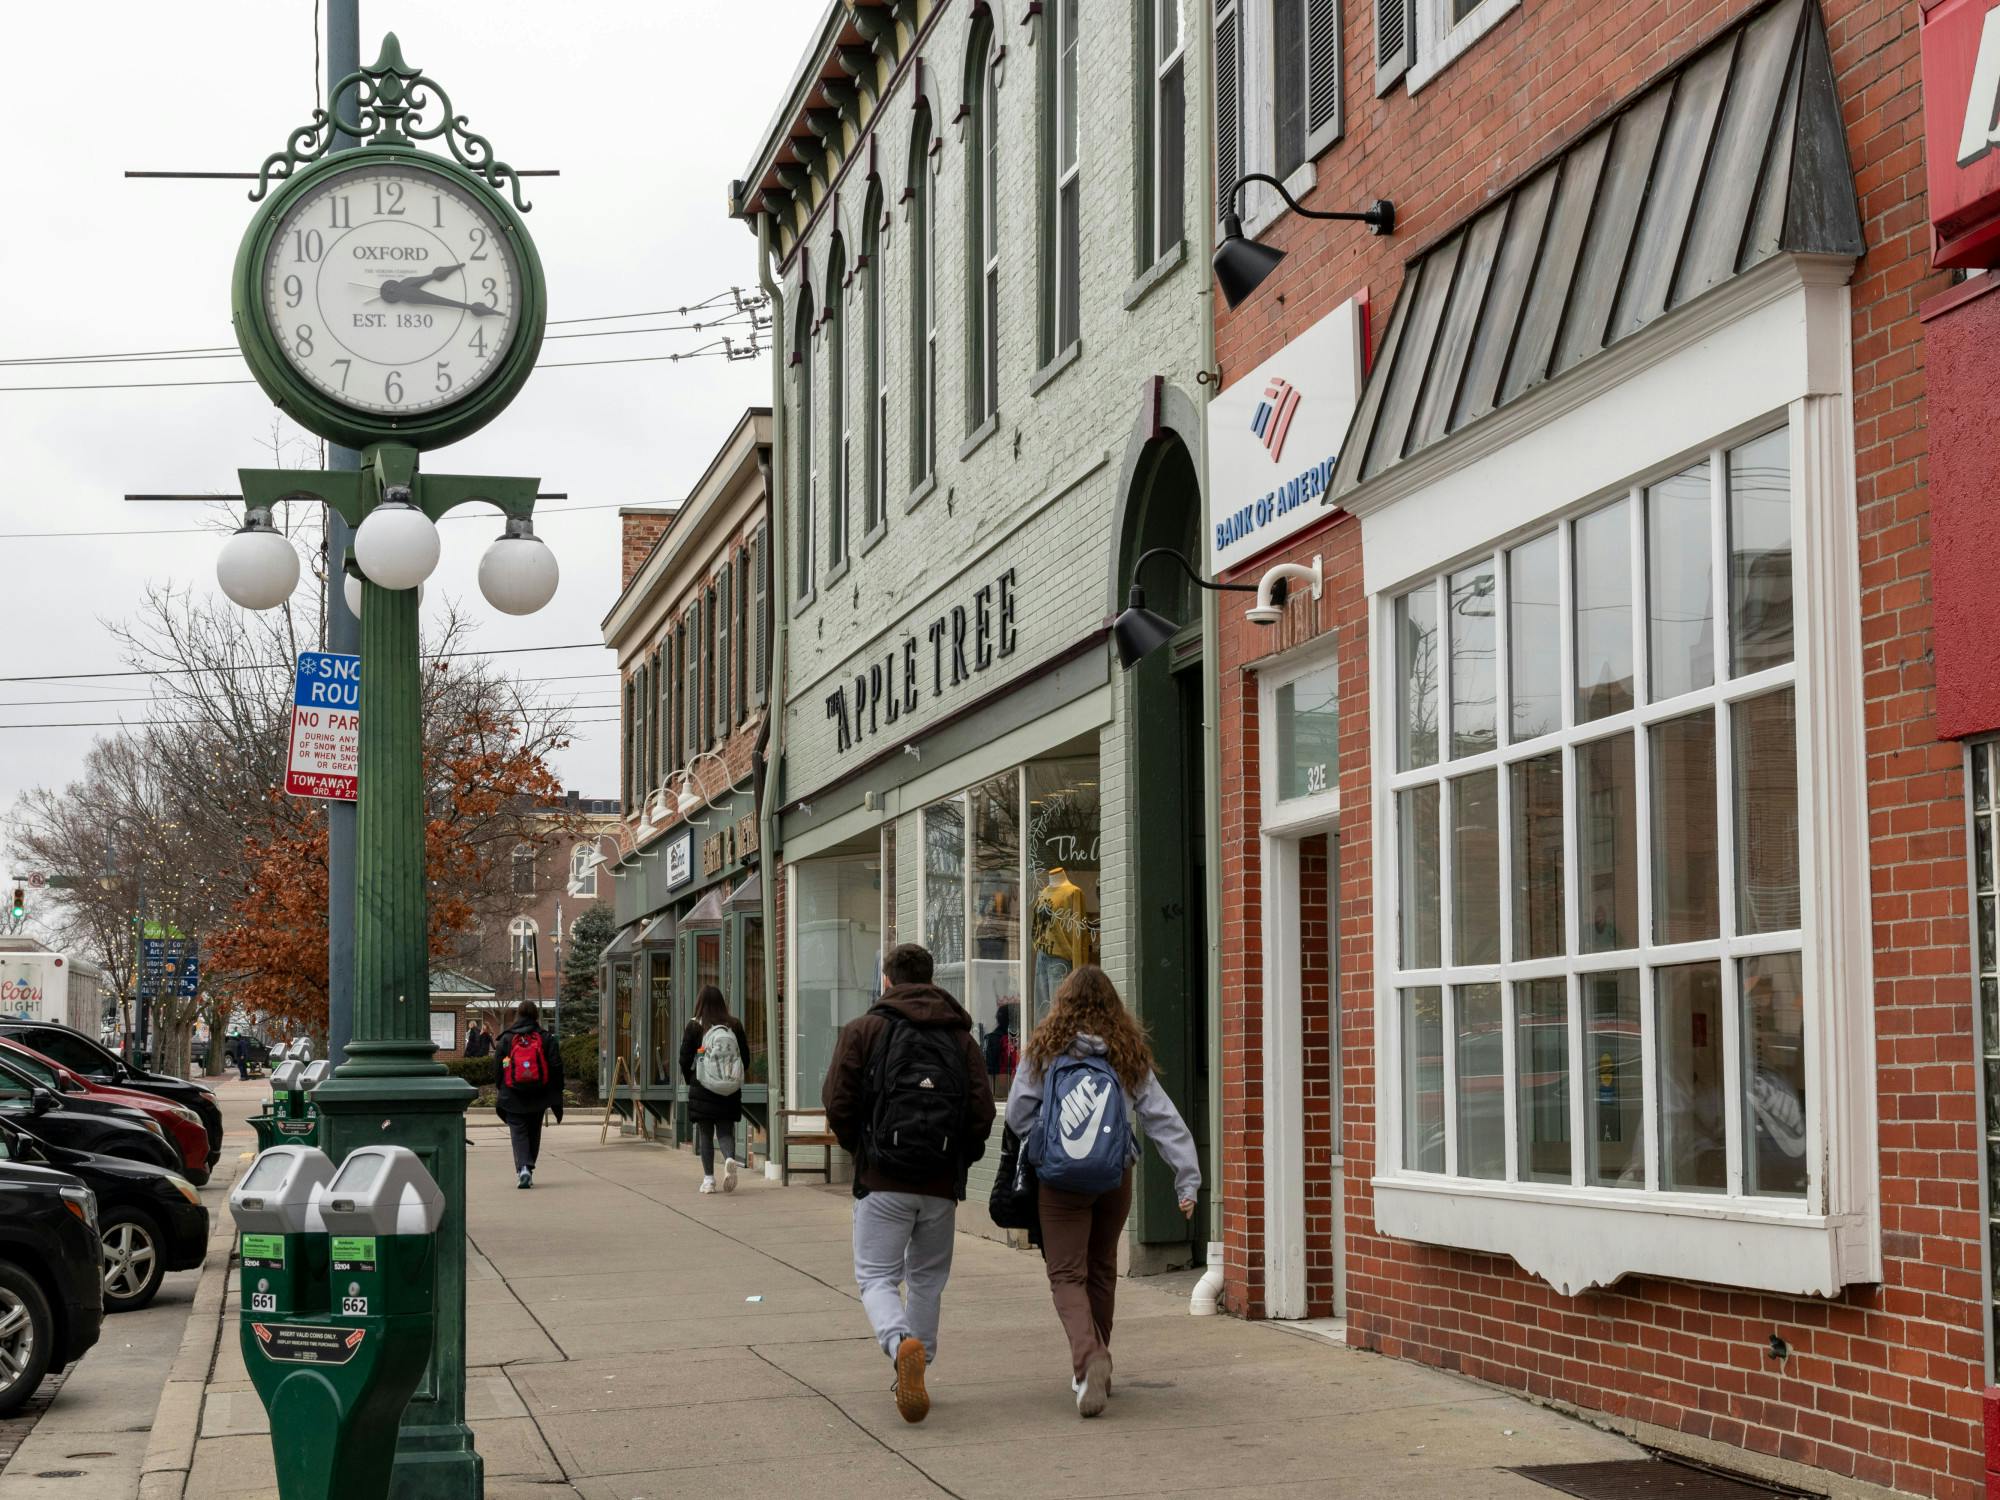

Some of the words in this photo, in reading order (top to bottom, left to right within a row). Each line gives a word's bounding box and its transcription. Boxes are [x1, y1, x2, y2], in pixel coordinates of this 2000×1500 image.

[327, 196, 353, 228] 11
[371, 181, 406, 216] 12
[432, 195, 446, 228] 1
[293, 229, 324, 263] 10
[352, 246, 429, 261] OXFORD
[468, 228, 489, 261] 2
[283, 274, 303, 308] 9
[481, 277, 499, 310] 3
[351, 314, 387, 328] EST.
[396, 314, 433, 329] 1830
[295, 324, 314, 359] 8
[467, 325, 489, 359] 4
[329, 358, 352, 392] 7
[384, 370, 404, 405] 6
[434, 360, 453, 393] 5
[1215, 504, 1253, 551] BANK
[1255, 492, 1275, 527] OF
[1276, 456, 1336, 517] AMERIC
[318, 658, 361, 681] SNO
[836, 636, 918, 754] APPLE
[928, 568, 1018, 697] TREE
[311, 681, 359, 705] ROU
[298, 711, 319, 728] NO
[304, 732, 335, 742] DURING
[338, 735, 356, 743] ANY
[313, 743, 337, 751] SNOW
[299, 750, 310, 758] OR
[314, 752, 337, 760] WHEN
[317, 761, 328, 769] OR
[332, 762, 358, 771] GREAT
[292, 774, 353, 790] TOW-AWAY
[1307, 764, 1327, 792] 32E
[1045, 835, 1088, 862] The
[4, 1001, 40, 1012] LIGHT
[1059, 1075, 1100, 1137] NIKE
[253, 1294, 273, 1309] 661
[343, 1298, 366, 1313] 662
